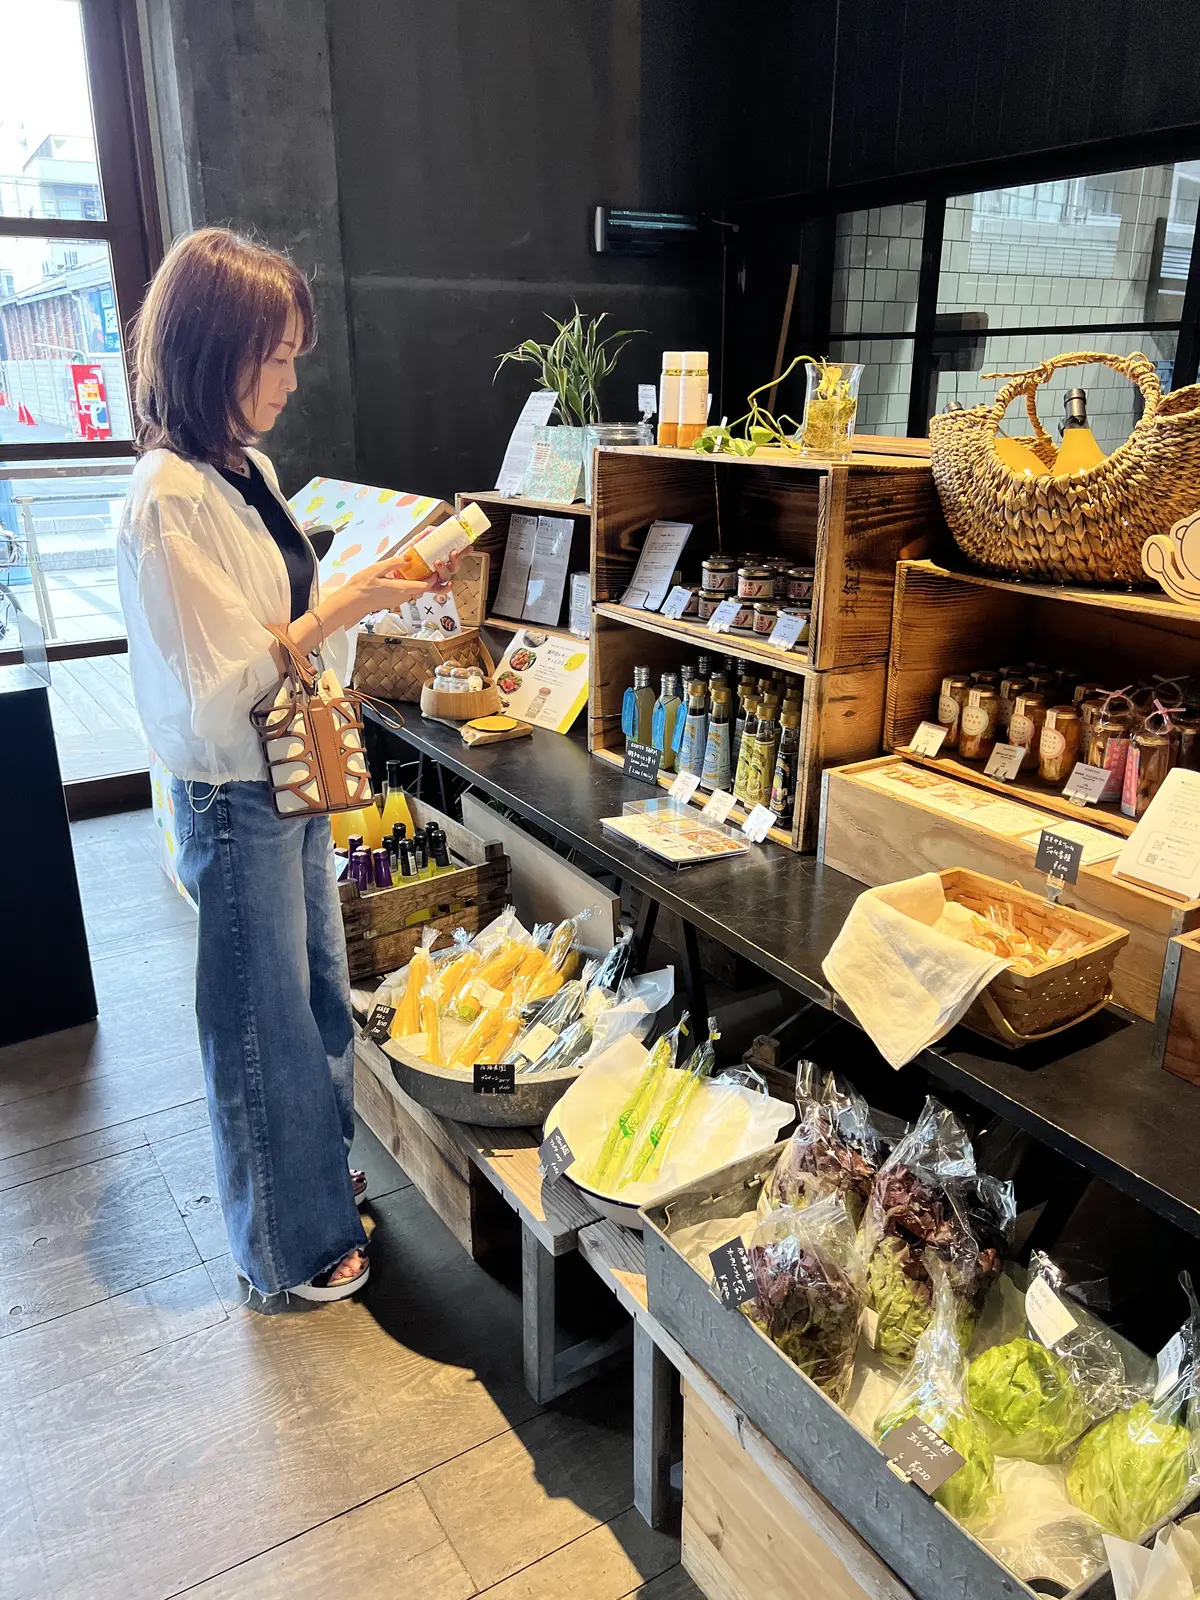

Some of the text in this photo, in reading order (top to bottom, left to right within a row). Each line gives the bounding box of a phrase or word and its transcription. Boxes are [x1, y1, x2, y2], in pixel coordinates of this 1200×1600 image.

[540, 519, 553, 528] BALI
[906, 1431, 939, 1461] 玉レタス
[908, 1459, 932, 1481] ¥220
